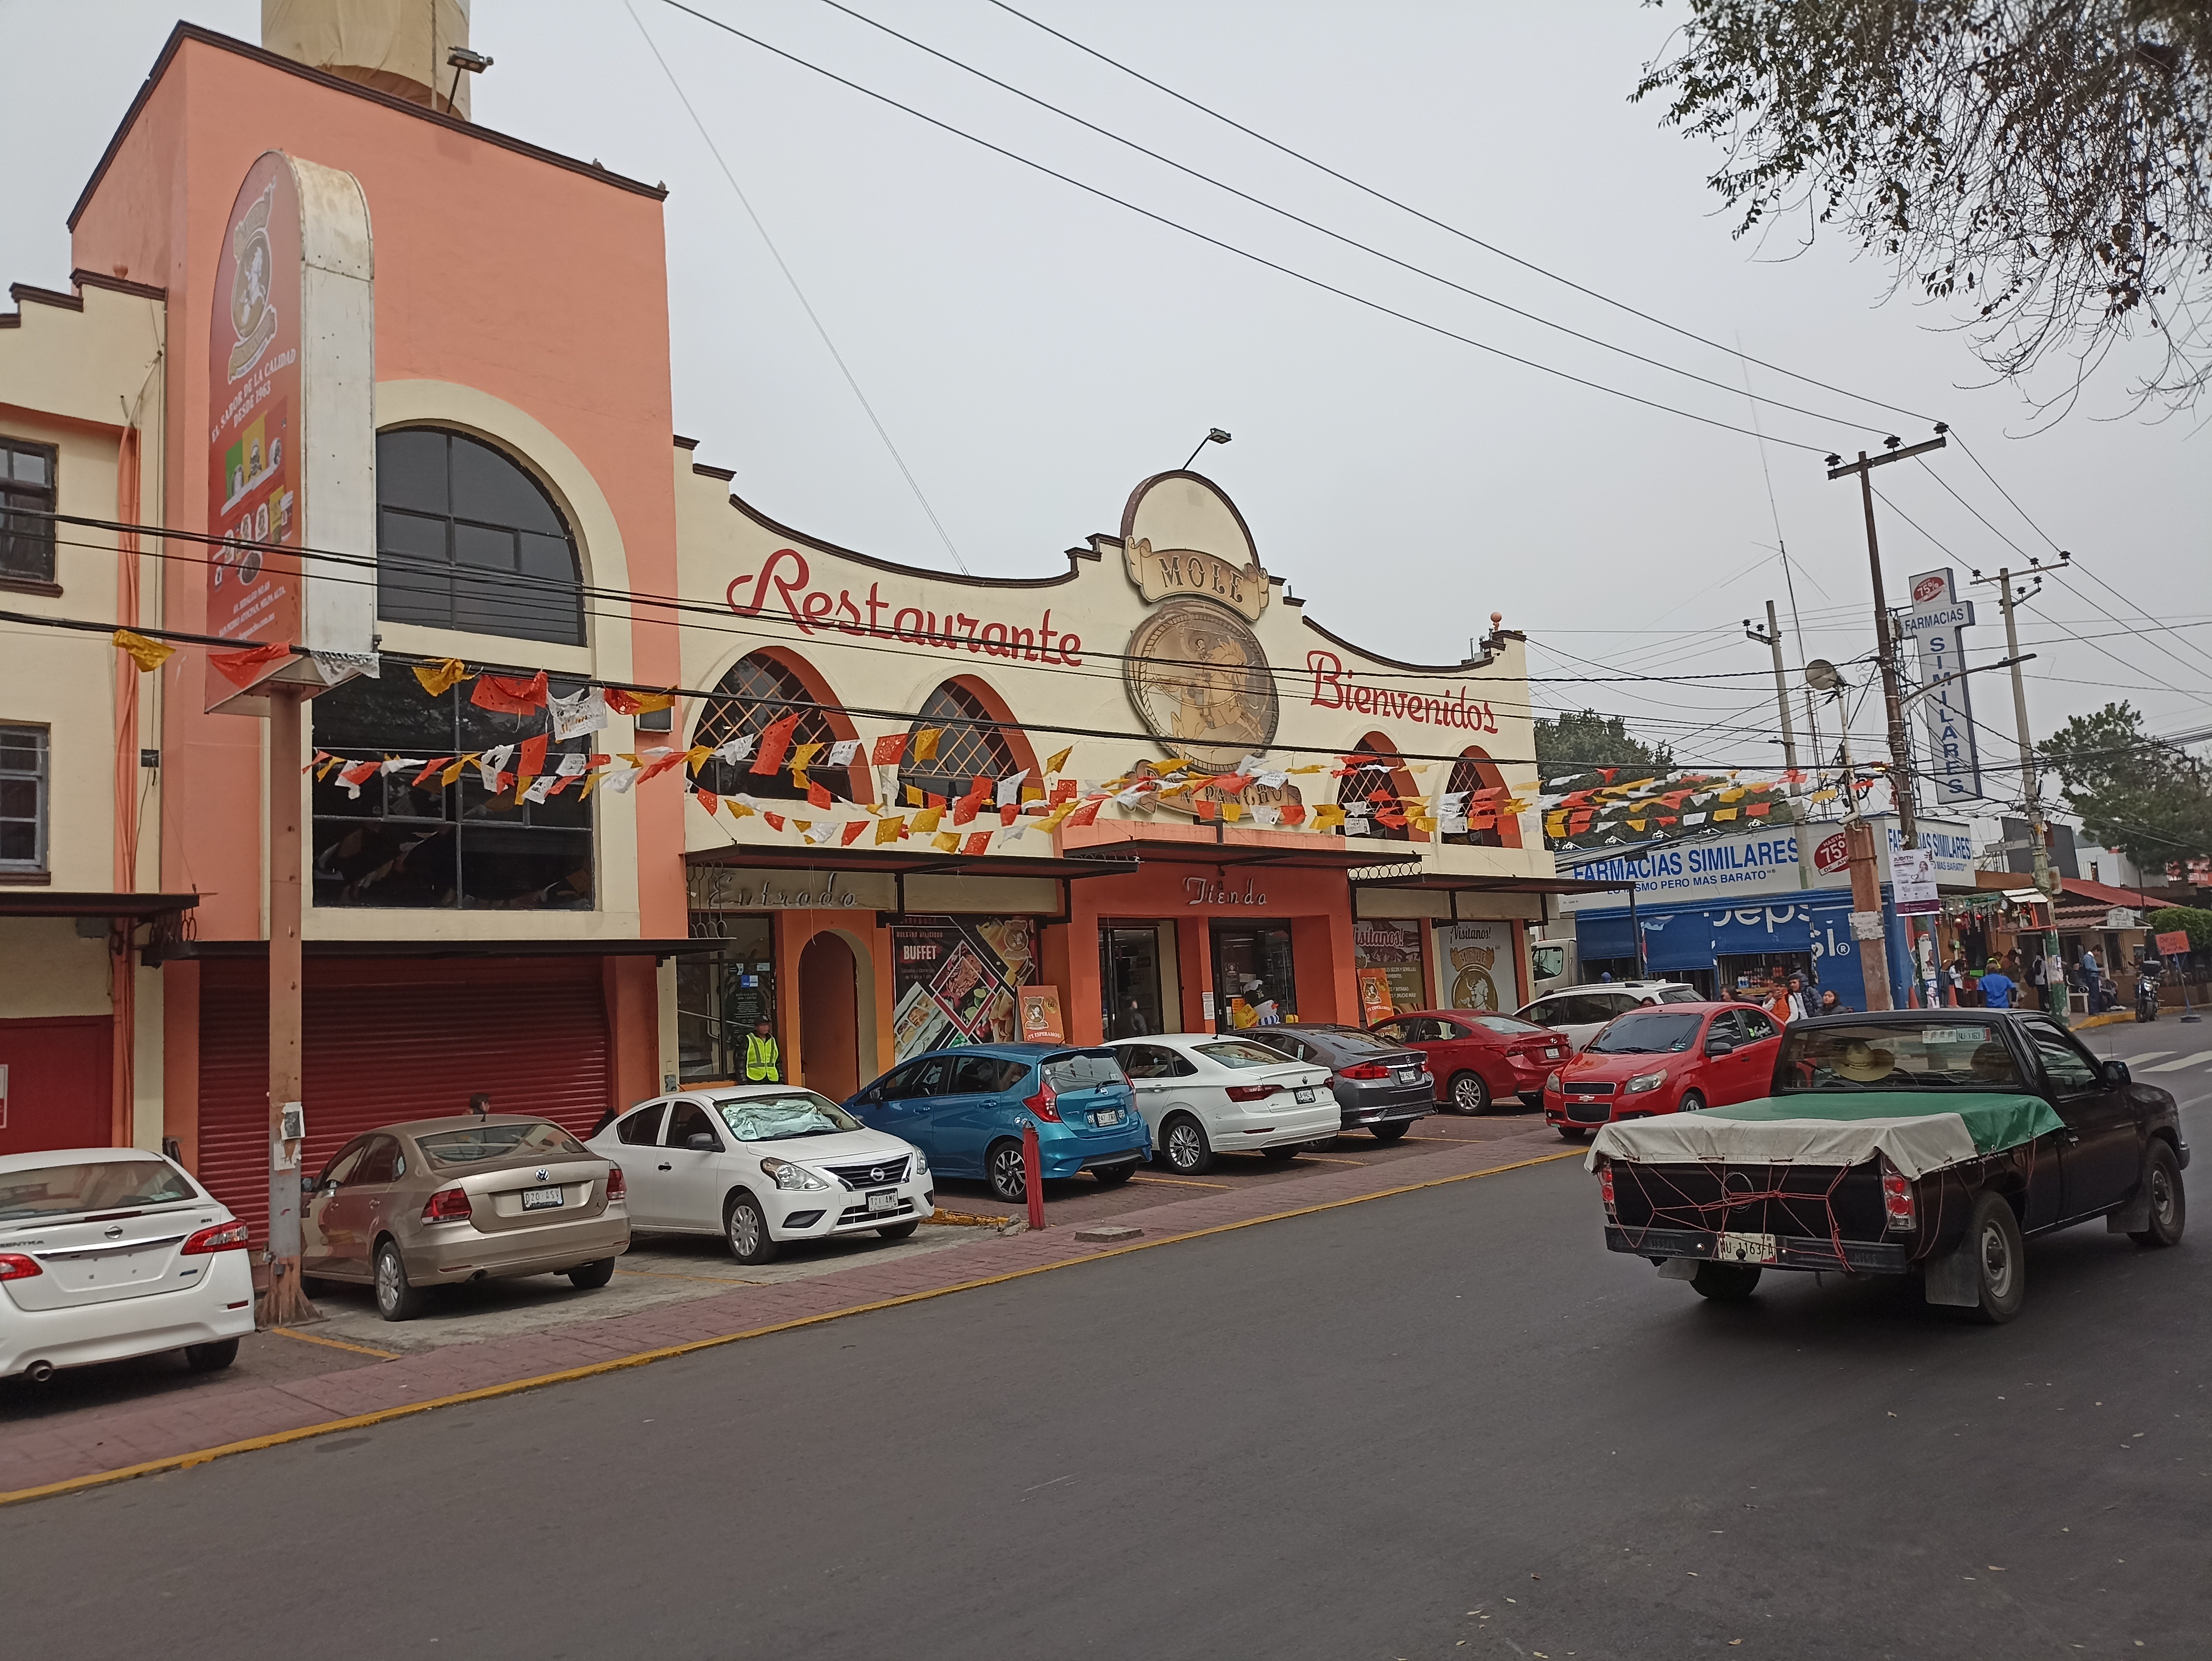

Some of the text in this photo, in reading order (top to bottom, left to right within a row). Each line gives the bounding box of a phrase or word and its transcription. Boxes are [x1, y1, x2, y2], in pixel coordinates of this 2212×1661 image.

[221, 391, 242, 429] SABOR
[244, 378, 252, 397] DE
[254, 369, 263, 387] LA
[265, 348, 296, 377] CALIDAD
[234, 394, 254, 428] DESDE
[1159, 556, 1243, 603] MOLE
[1917, 580, 1938, 596] 75%
[727, 548, 1082, 666] Restaurante
[1905, 608, 1964, 631] FARMACIAS
[1307, 650, 1498, 734] Bienvenidos
[1930, 637, 1964, 794] SIMILARES
[1823, 835, 1843, 847] HASTA
[1933, 834, 1970, 860] SIMILARES
[1574, 838, 1799, 881] FARMACIAS SIMILARES
[709, 872, 857, 908] Entrada
[1183, 877, 1267, 905] Tienda
[1624, 882, 1658, 893] SMO
[1661, 878, 1690, 890] PERO
[1693, 875, 1717, 886] MAS
[904, 945, 937, 960] BUFFET
[1459, 950, 1486, 963] MOLE
